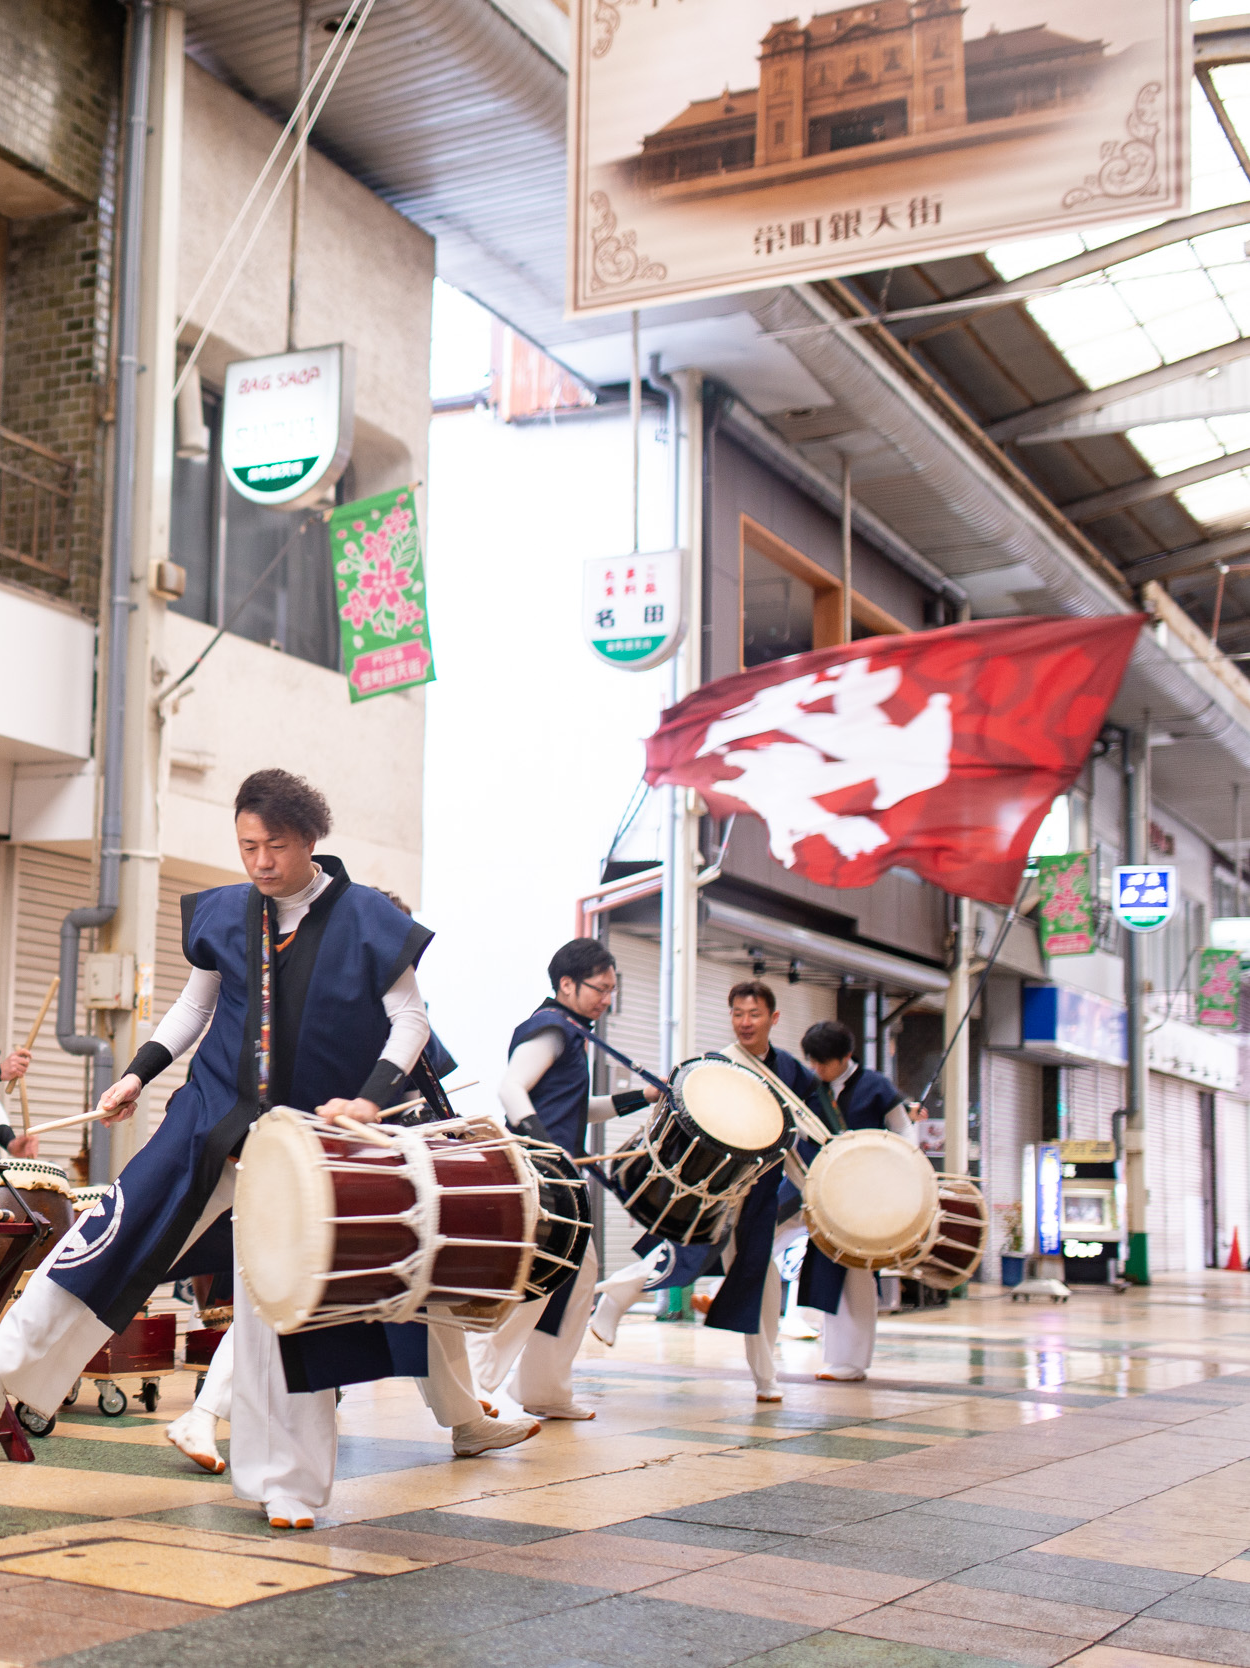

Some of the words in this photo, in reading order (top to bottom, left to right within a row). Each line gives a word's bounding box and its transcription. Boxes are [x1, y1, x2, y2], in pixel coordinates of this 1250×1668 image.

[754, 194, 943, 256] 栄町銀天街
[237, 375, 271, 395] BAG
[595, 605, 664, 628] 名田
